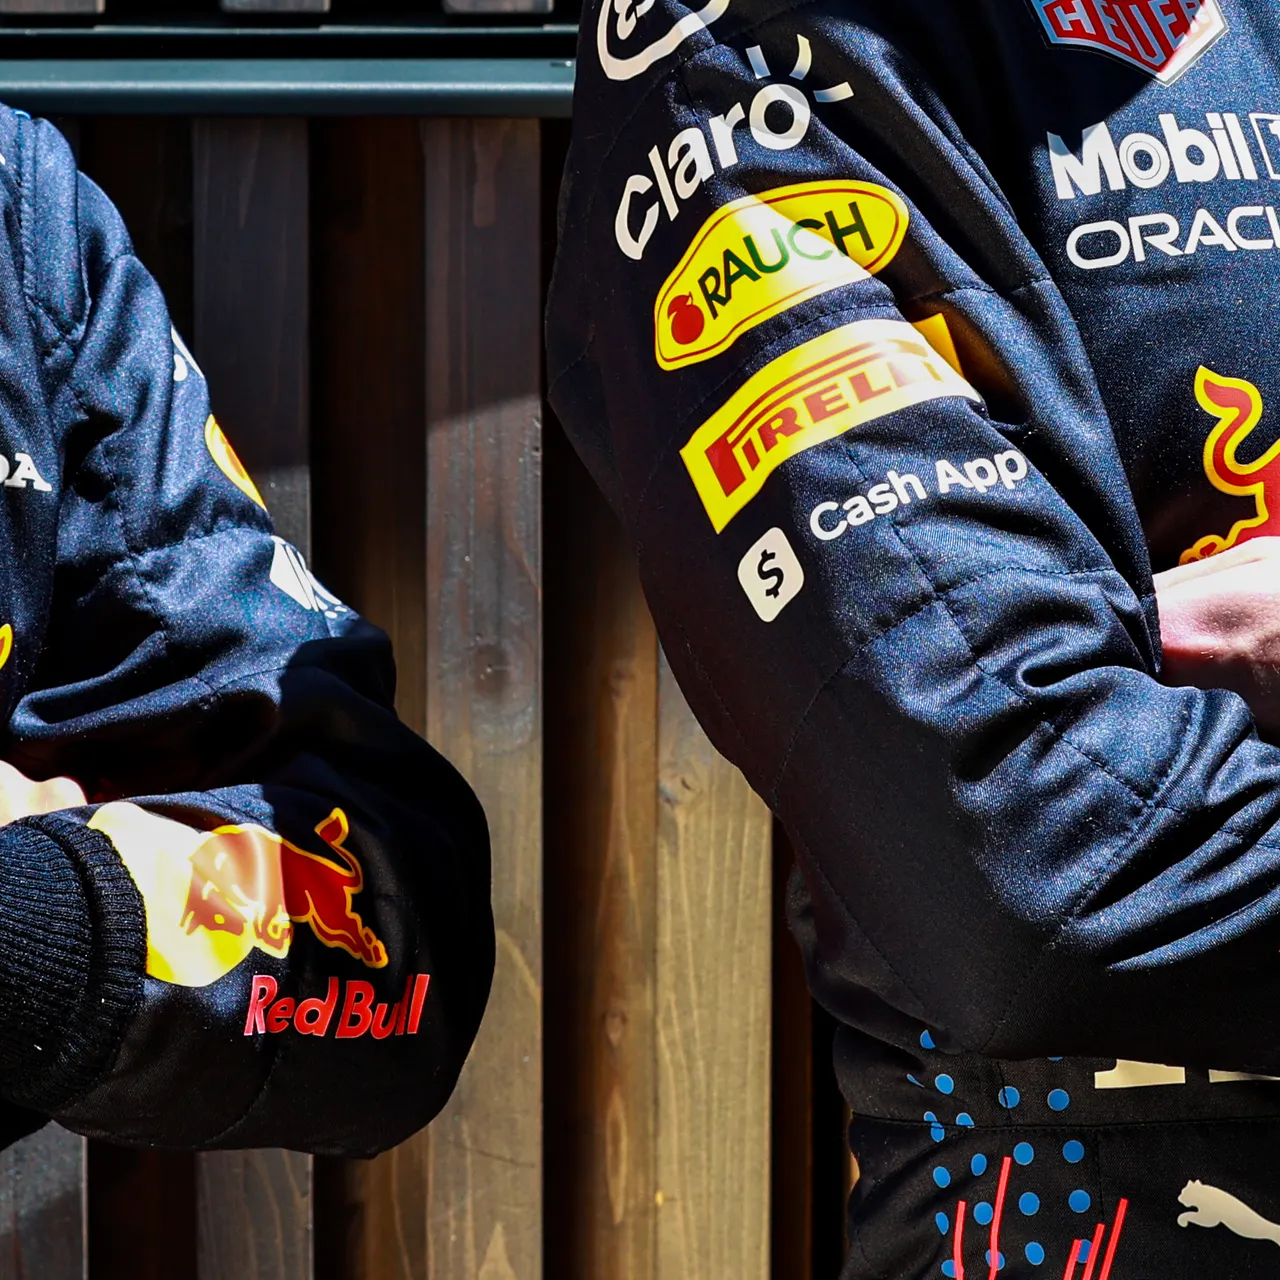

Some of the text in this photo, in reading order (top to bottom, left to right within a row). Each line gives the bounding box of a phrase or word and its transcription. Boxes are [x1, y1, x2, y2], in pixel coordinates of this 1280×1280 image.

[1046, 113, 1258, 200] Mobil
[699, 200, 875, 319] RAUCH
[809, 449, 1027, 541] Cash App
[244, 973, 430, 1040] Red Bull
